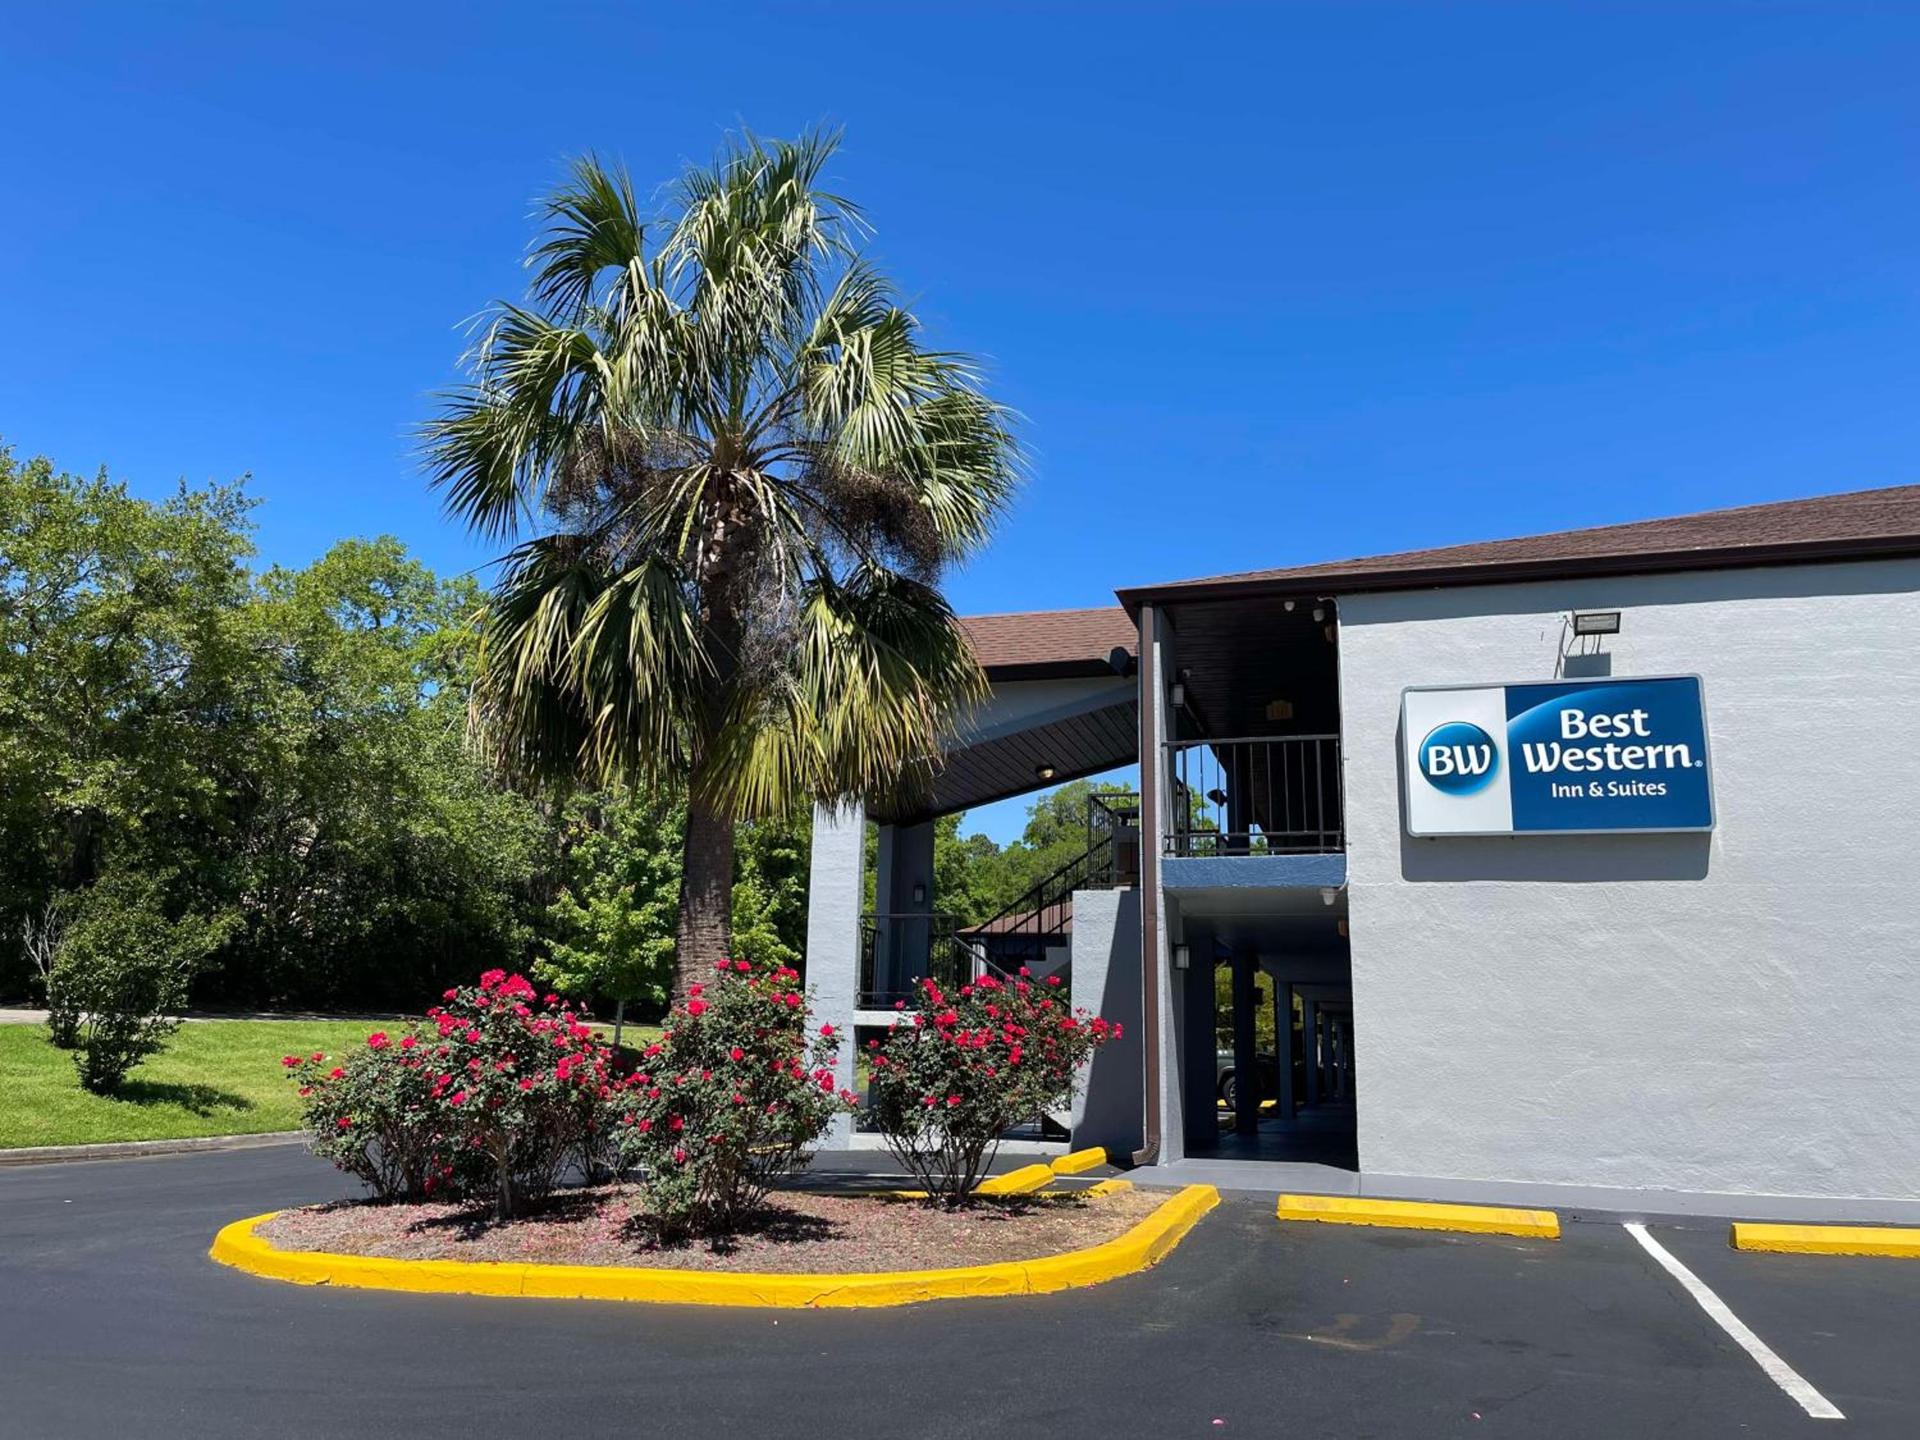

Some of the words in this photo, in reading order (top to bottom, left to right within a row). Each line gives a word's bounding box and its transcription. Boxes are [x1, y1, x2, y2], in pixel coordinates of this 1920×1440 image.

[1560, 708, 1651, 739] Best
[1428, 744, 1491, 776] BW
[1522, 743, 1692, 773] Western
[1551, 782, 1584, 798] Inn
[1588, 782, 1604, 797] &
[1607, 780, 1667, 797] Suites
